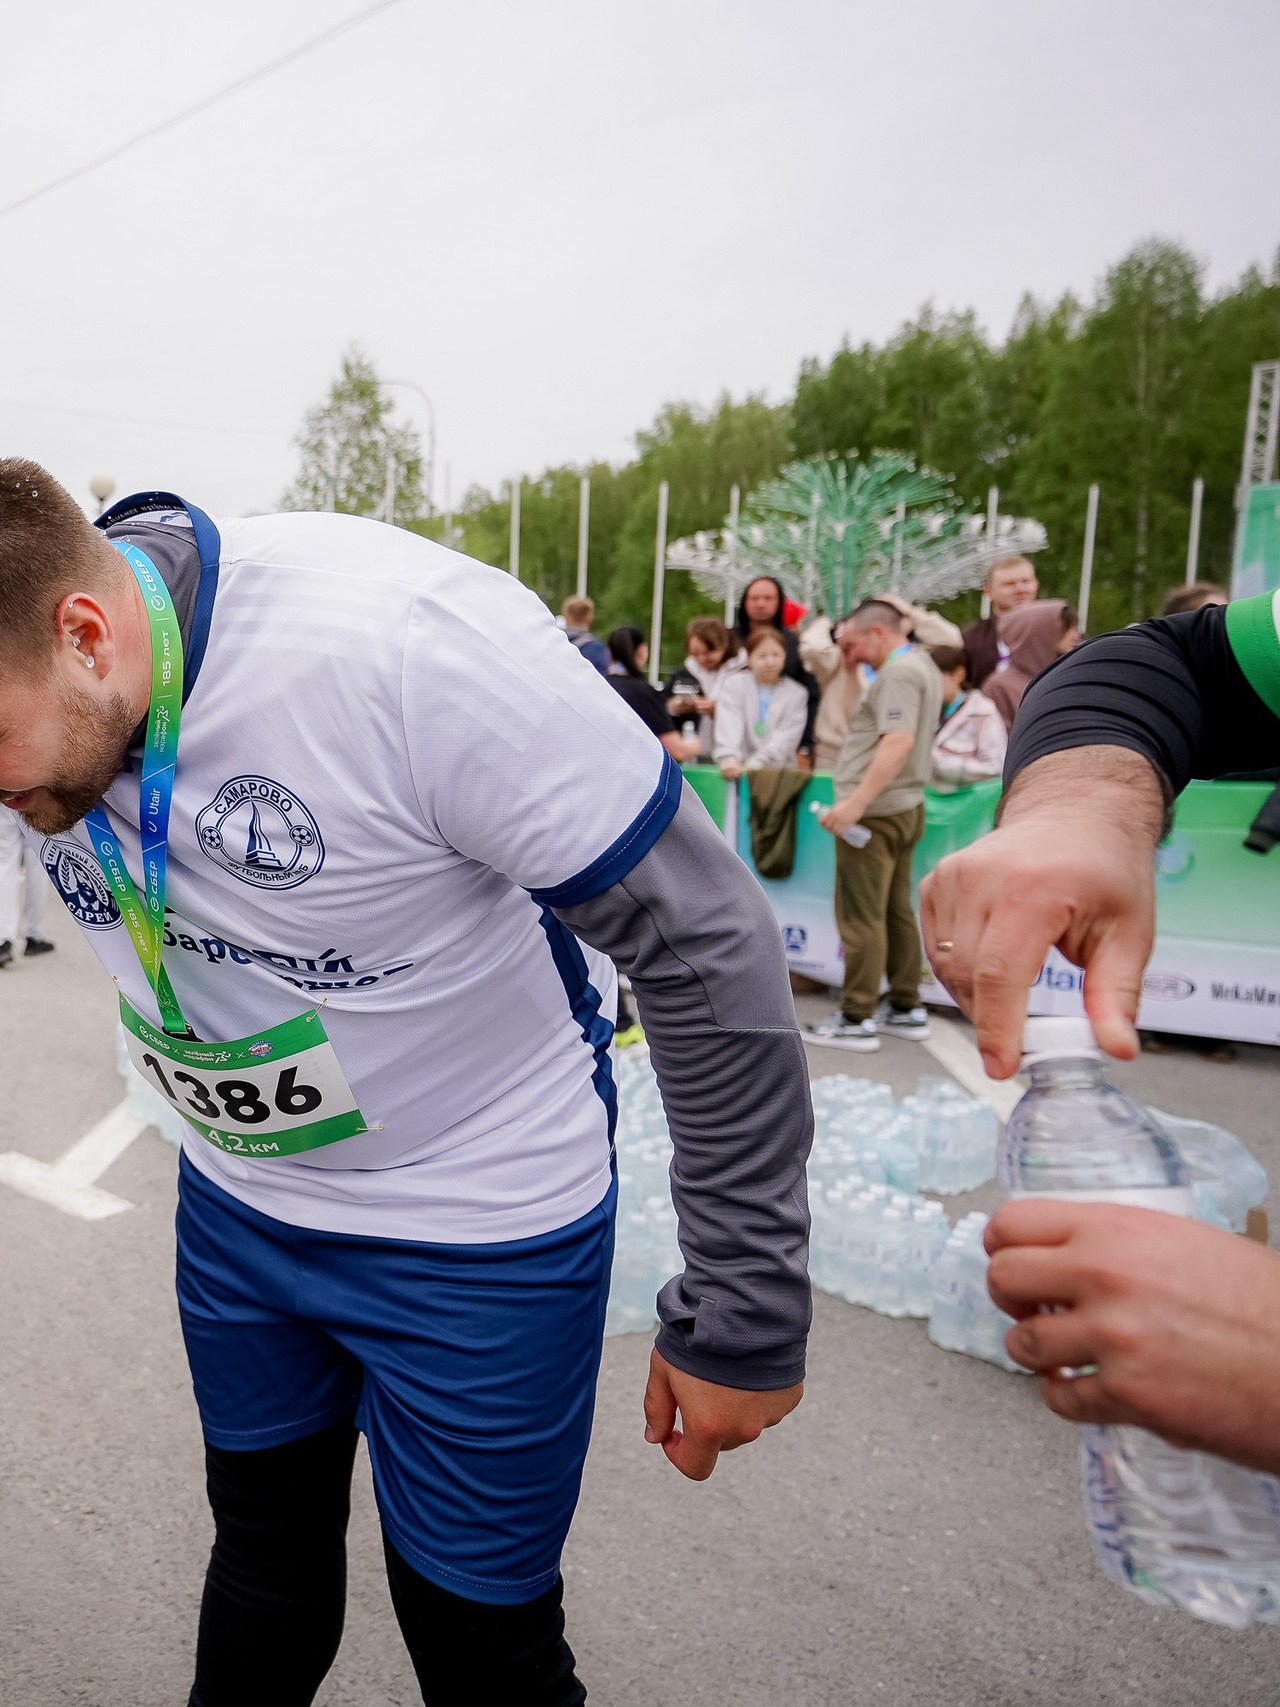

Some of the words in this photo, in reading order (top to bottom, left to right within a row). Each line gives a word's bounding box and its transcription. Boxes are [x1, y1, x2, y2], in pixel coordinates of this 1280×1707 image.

[135, 559, 158, 592] СБЕР
[162, 630, 171, 657] лет
[162, 660, 172, 687] 185
[160, 721, 169, 753] марафон
[148, 788, 161, 816] Utair
[214, 782, 293, 815] САМАРОВО
[108, 858, 127, 892] СБЕР
[148, 860, 159, 896] СБЕР
[67, 901, 113, 923] САРЕЙ
[127, 906, 141, 928] 185
[135, 931, 149, 953] лет
[1032, 965, 1086, 992] tai
[149, 1034, 170, 1050] СБЕР
[142, 1052, 323, 1124] 1386
